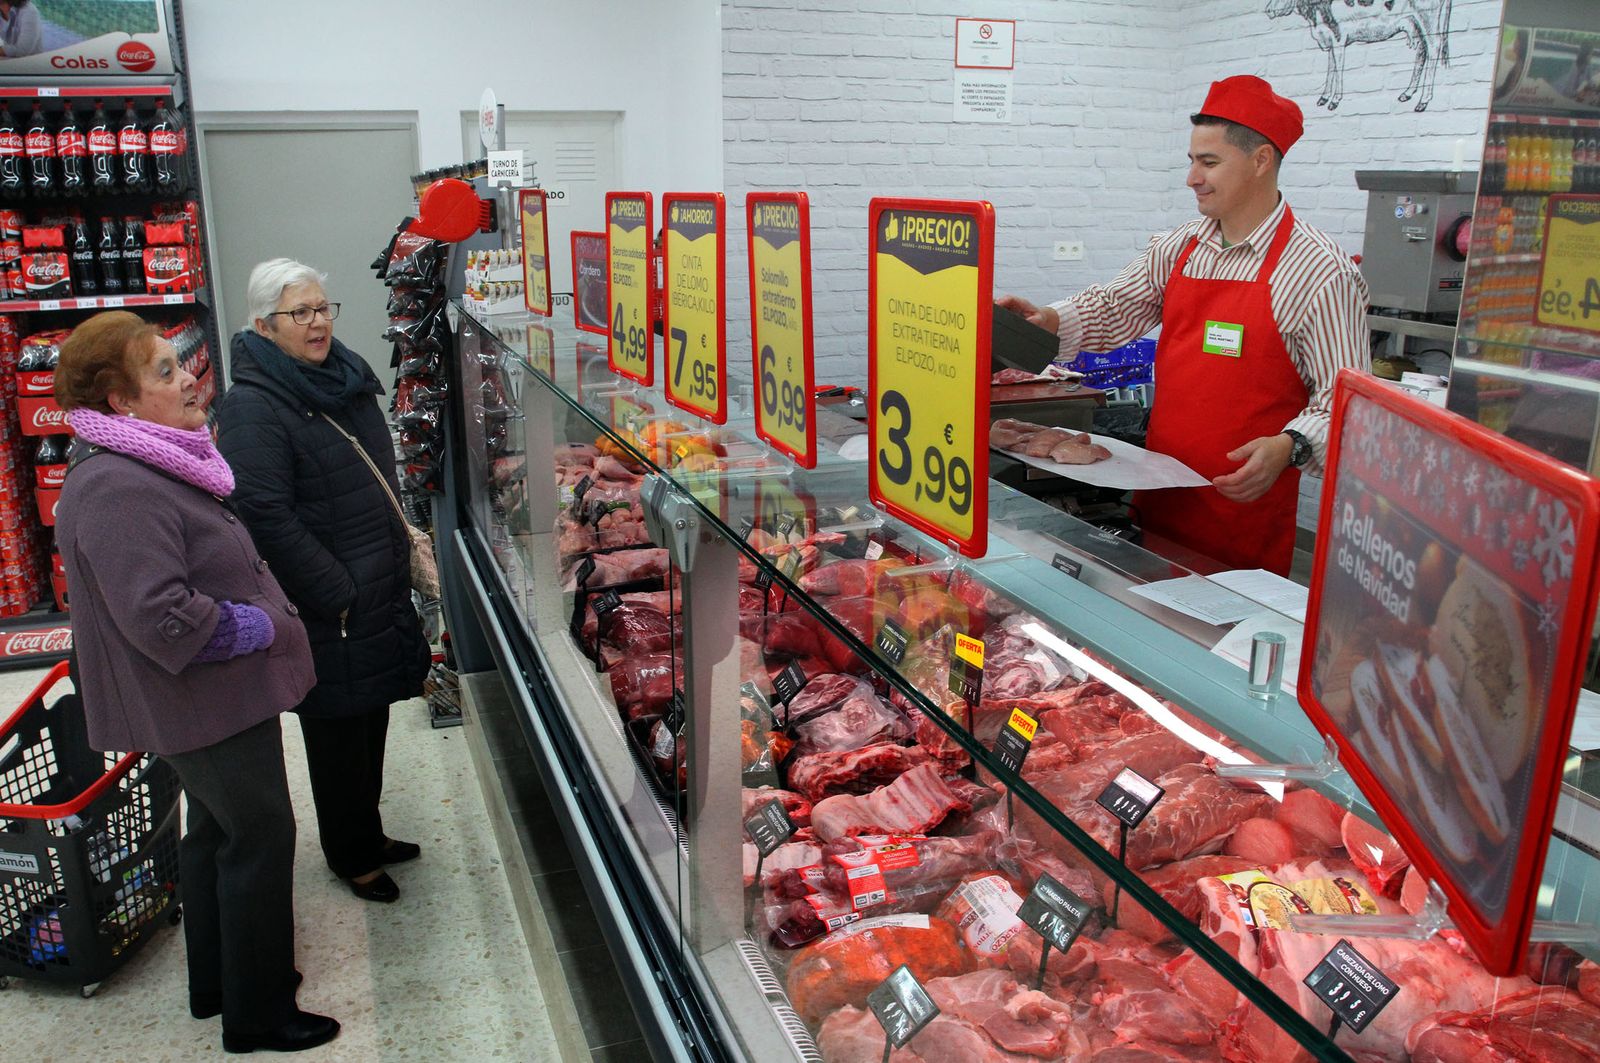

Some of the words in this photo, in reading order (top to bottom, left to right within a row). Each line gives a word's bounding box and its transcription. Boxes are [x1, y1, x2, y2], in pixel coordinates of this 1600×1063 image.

[50, 55, 109, 70] Colas
[120, 50, 150, 60] Coca-Cola
[545, 191, 564, 199] ADO
[618, 200, 645, 218] ¡PRECIO!
[680, 207, 713, 224] ¡AHORRO!
[762, 206, 799, 230] ¡PRECIO!
[902, 216, 971, 248] ¡PRECIO!
[27, 264, 65, 276] Coca-Cola
[149, 258, 184, 270] Coca-Cola
[682, 254, 702, 271] CINTA
[676, 273, 686, 288] DE
[687, 275, 708, 292] LOMO
[761, 267, 789, 287] Solomillo
[762, 290, 796, 310] extratierno
[634, 308, 638, 320] €
[888, 298, 916, 317] CINTA
[919, 304, 933, 322] DE
[934, 308, 965, 331] LOMO
[612, 302, 646, 362] 4,99
[702, 334, 706, 348] €
[892, 322, 960, 354] EXTRATIERNA
[671, 327, 717, 400] 7,95
[787, 356, 792, 372] €
[896, 346, 937, 376] ELPOZO,
[938, 364, 956, 379] KILO
[760, 344, 806, 432] 6,99
[944, 424, 953, 445] €
[879, 390, 972, 516] 3,99
[1342, 502, 1416, 590] Rellenos
[1338, 544, 1354, 574] de
[1354, 559, 1412, 624] Navidad
[958, 638, 982, 655] OFERTA
[1012, 714, 1034, 735] OFERTA
[0, 855, 35, 868] amón
[1047, 888, 1064, 906] MAGRO
[1062, 900, 1082, 918] PALETA
[1337, 949, 1366, 976] CABEZADA
[1364, 972, 1374, 982] DE
[1371, 980, 1390, 995] LOMO
[1340, 964, 1353, 977] CON
[1352, 974, 1372, 992] HUESO
[1328, 982, 1361, 1009] 3,95
